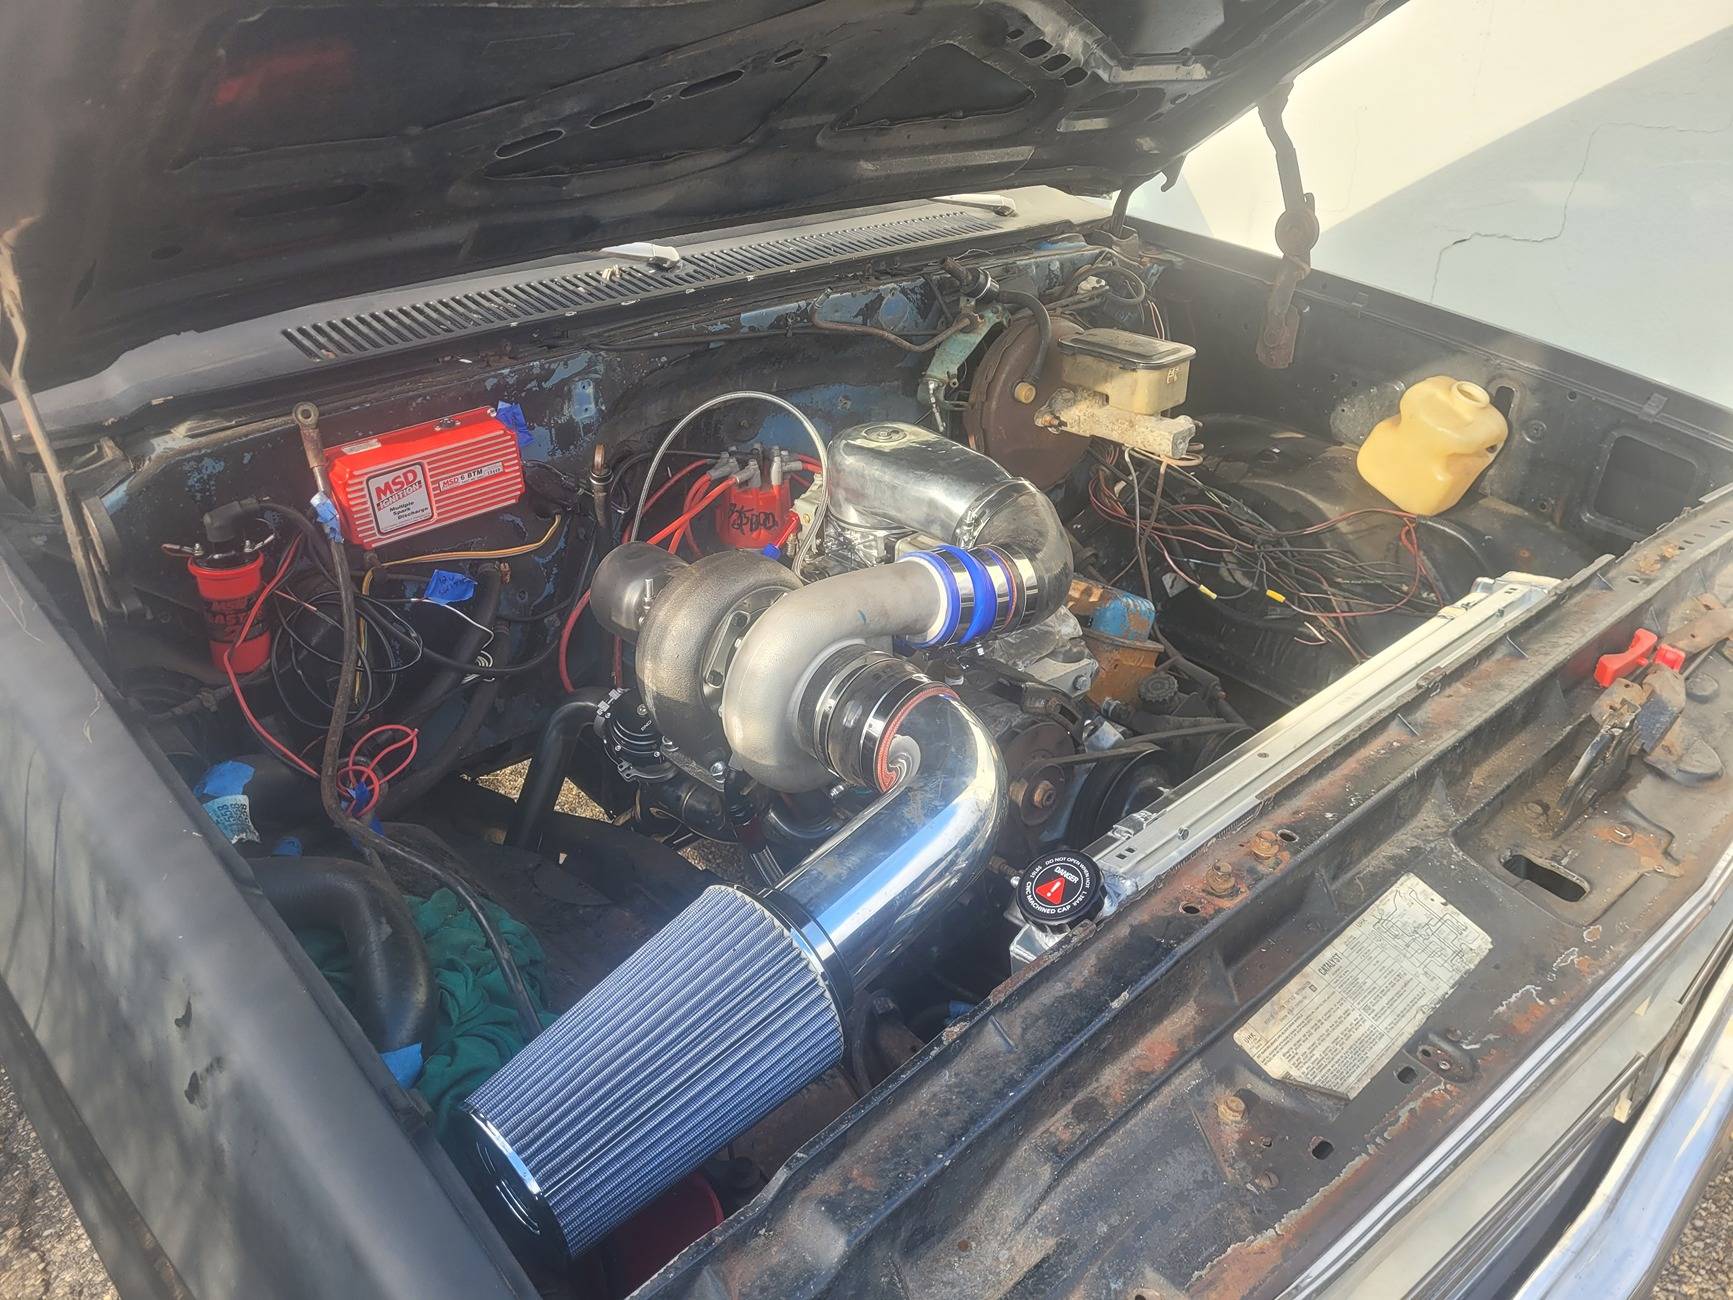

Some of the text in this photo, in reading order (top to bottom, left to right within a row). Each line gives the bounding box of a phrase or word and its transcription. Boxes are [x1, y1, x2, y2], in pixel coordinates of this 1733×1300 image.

[375, 469, 417, 501] MSD
[442, 477, 459, 488] MSD
[380, 482, 420, 510] IGNITION
[389, 501, 414, 512] Multiple
[1045, 858, 1055, 866] DO
[1066, 857, 1081, 866] OPEN
[1079, 863, 1090, 878] WHEN
[1054, 866, 1079, 884] DANGER
[1026, 895, 1056, 914] MACHINED
[1057, 905, 1071, 914] CAP
[1318, 952, 1343, 977] CATALYST
